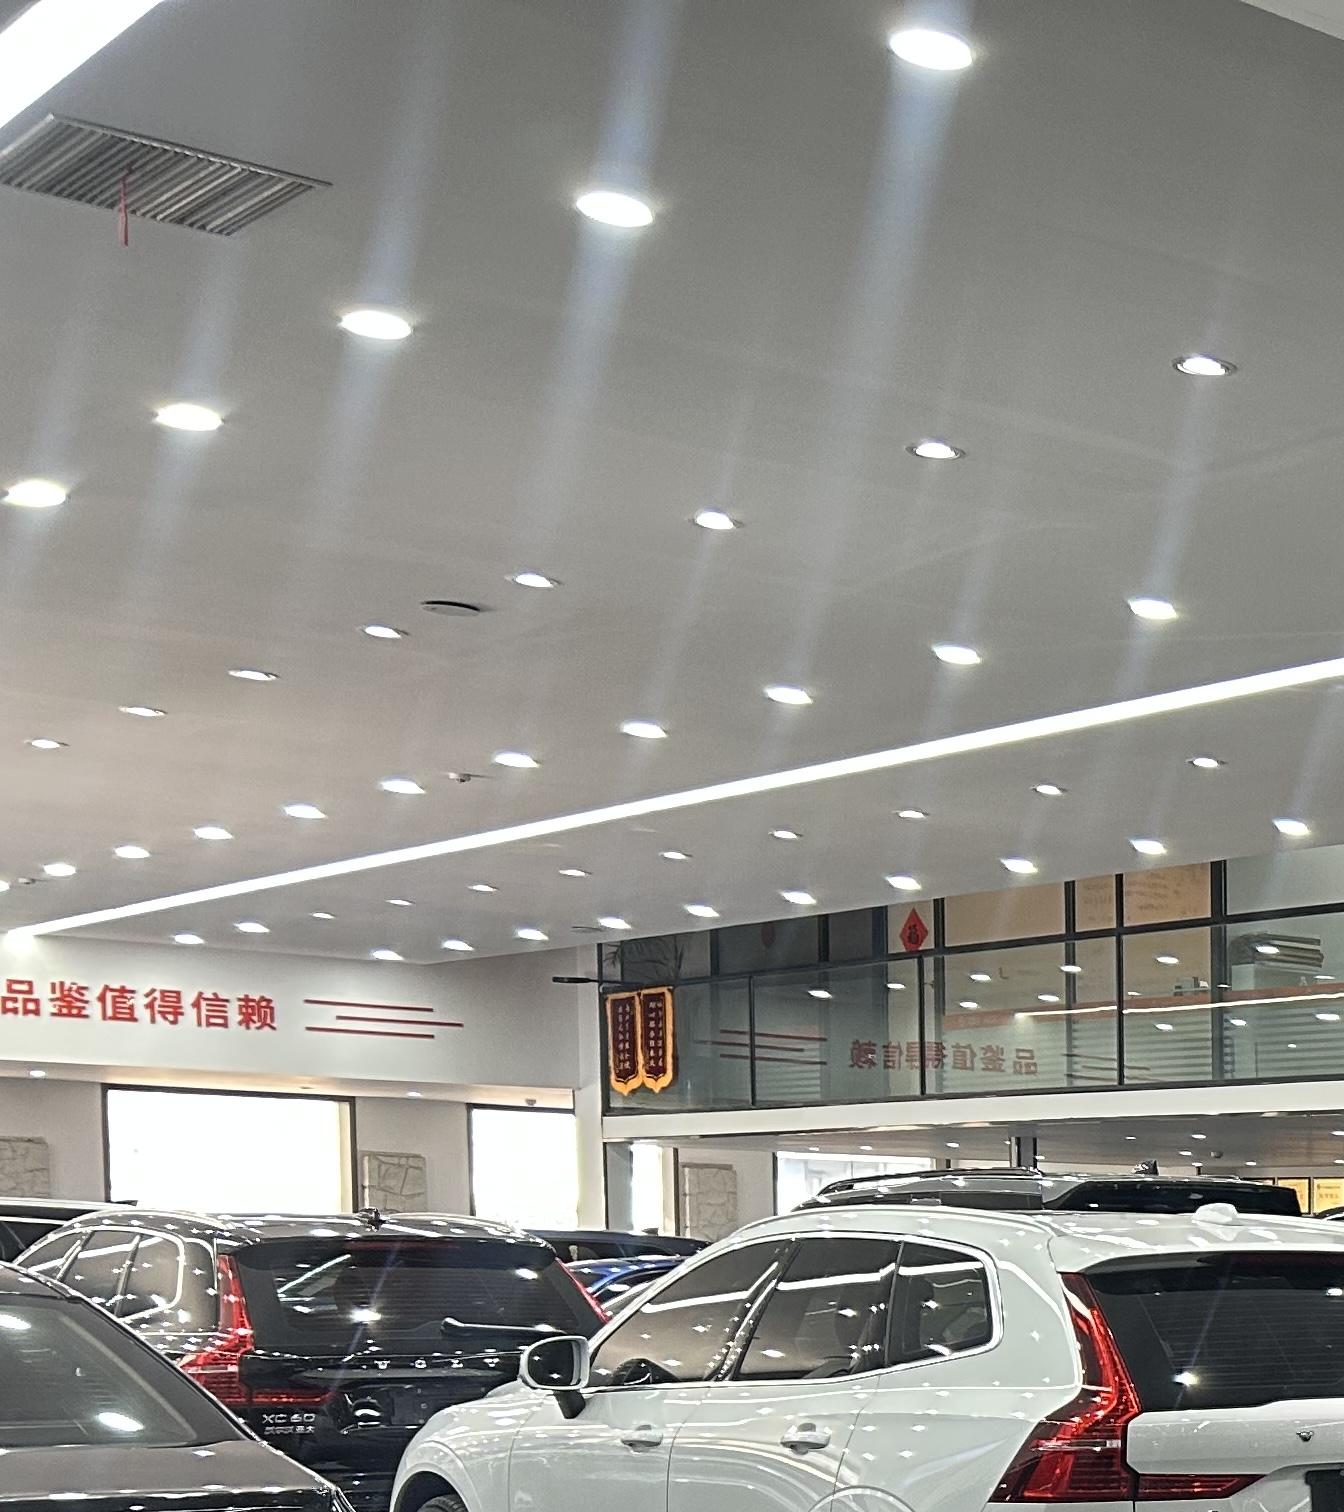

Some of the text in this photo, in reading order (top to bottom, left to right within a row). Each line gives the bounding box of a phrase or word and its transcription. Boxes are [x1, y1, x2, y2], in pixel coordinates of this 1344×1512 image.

[0, 978, 277, 1031] 品鉴值得信赖
